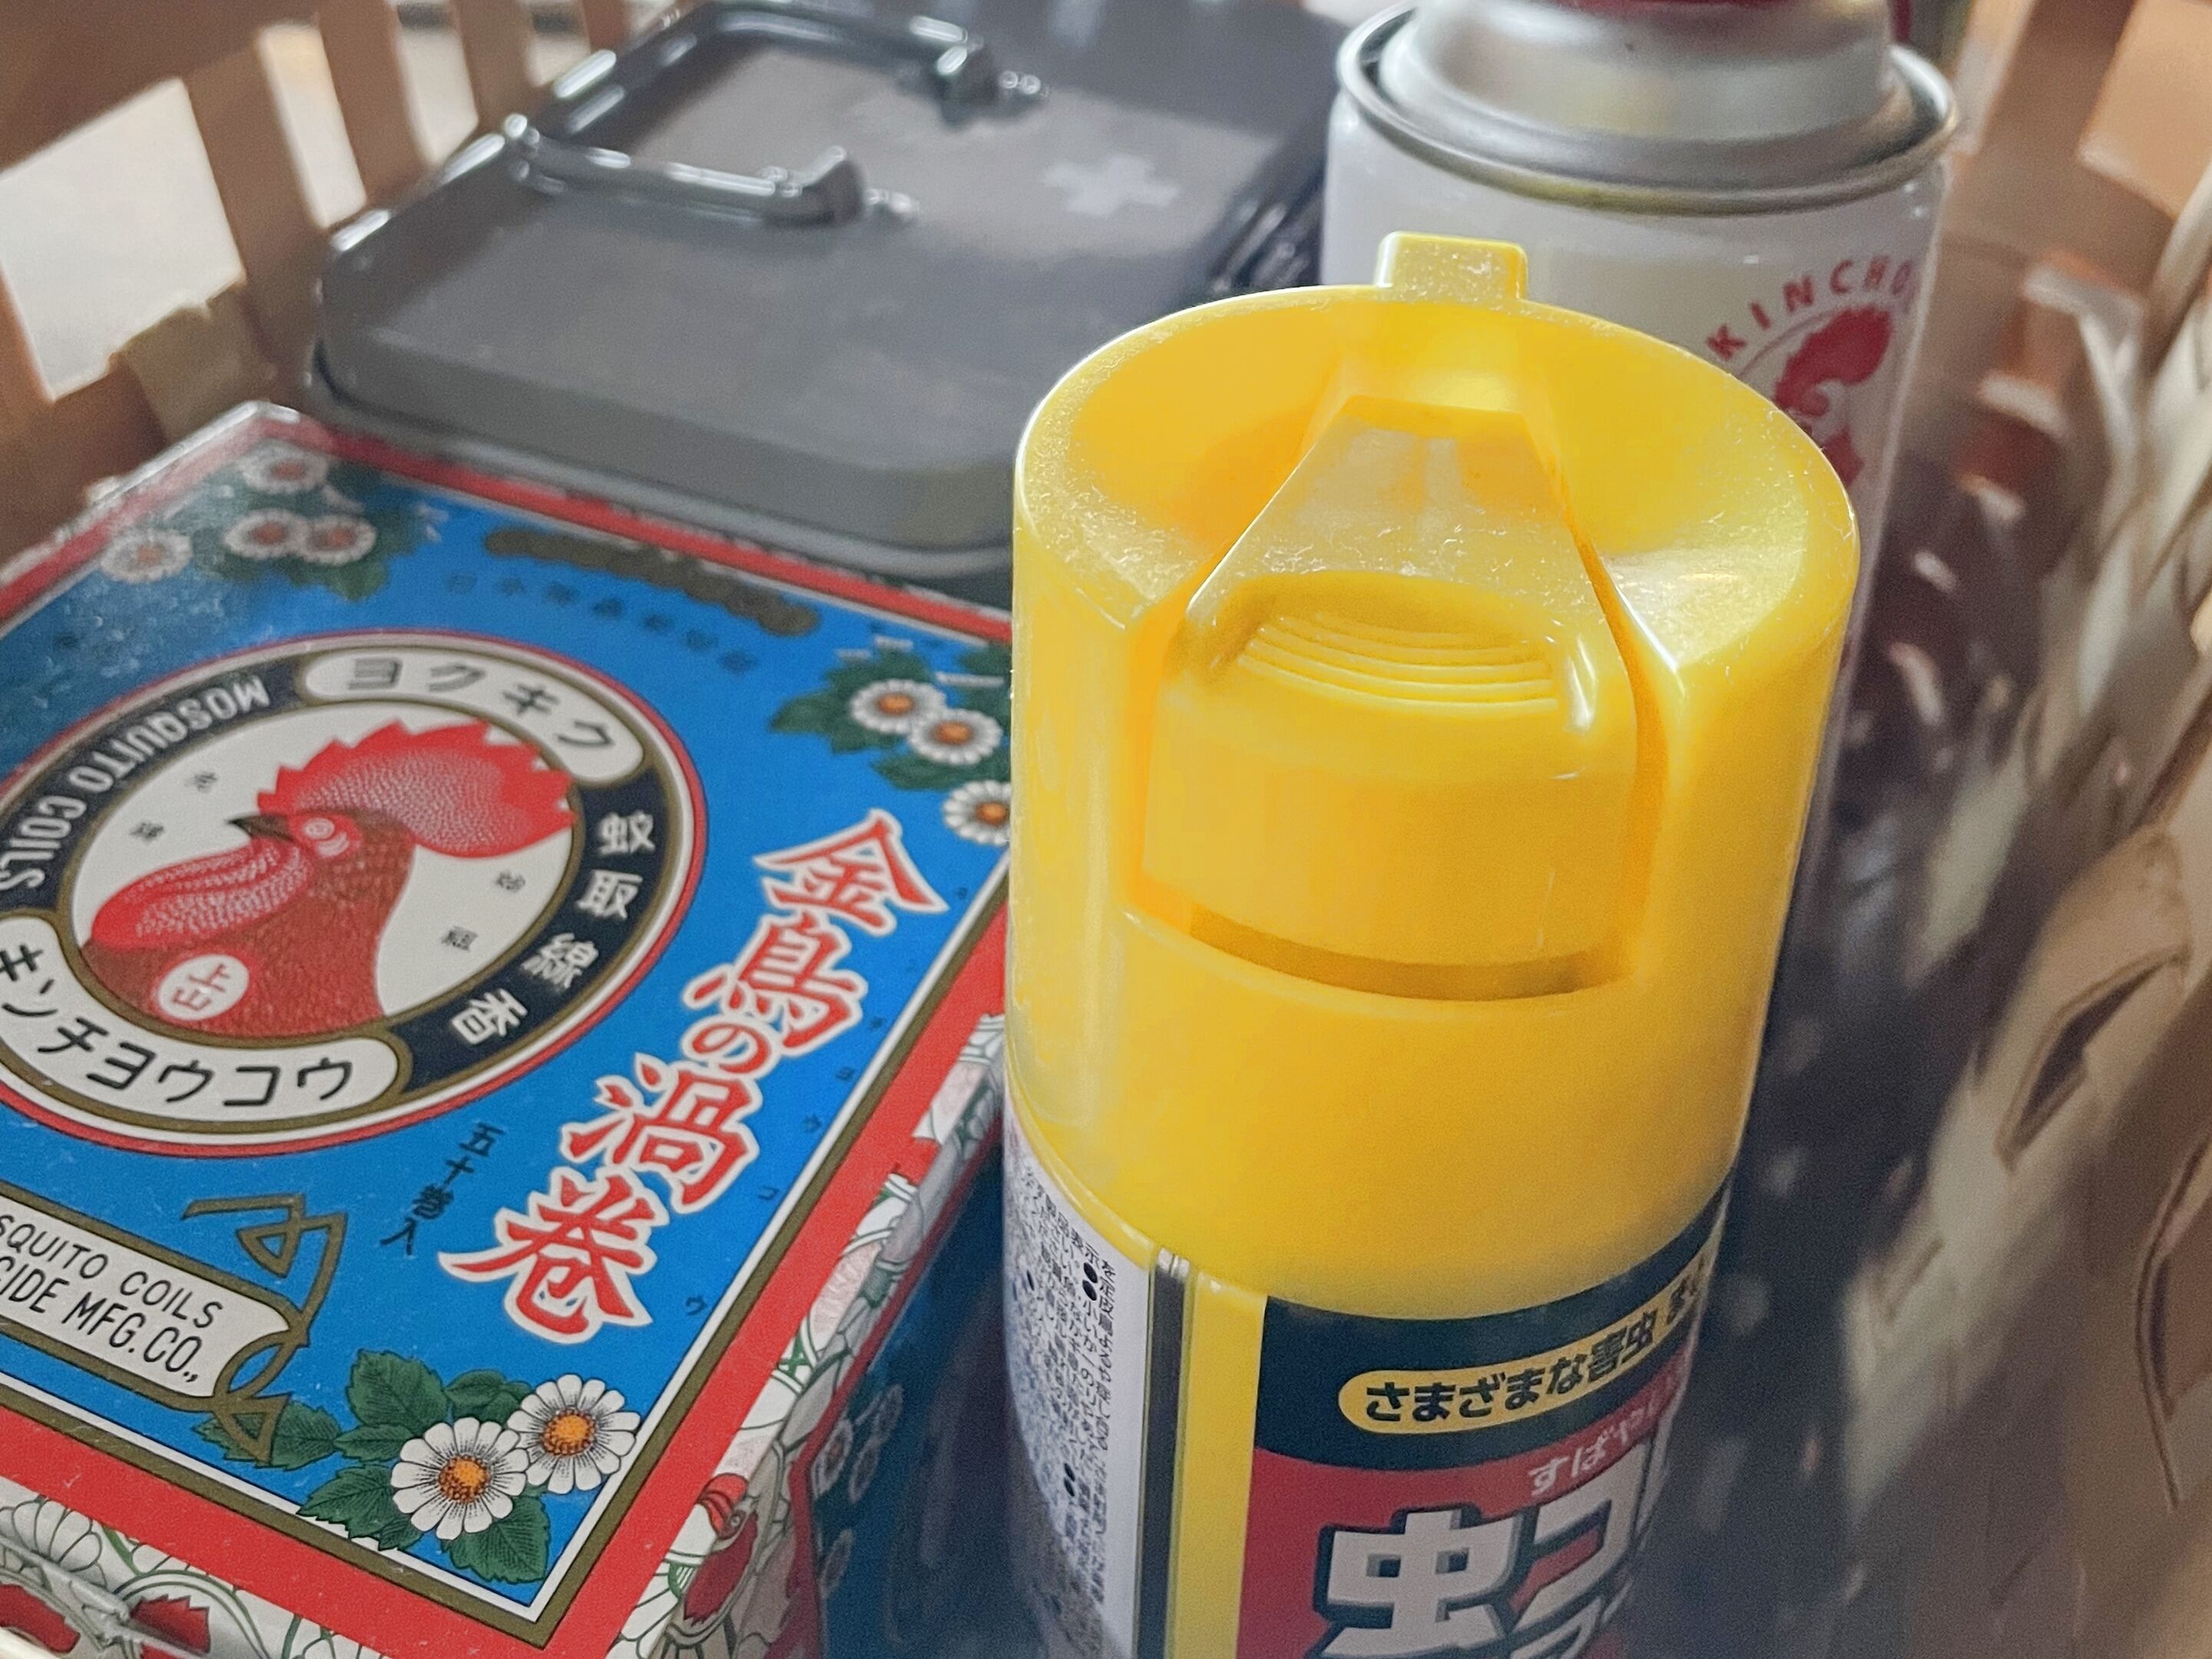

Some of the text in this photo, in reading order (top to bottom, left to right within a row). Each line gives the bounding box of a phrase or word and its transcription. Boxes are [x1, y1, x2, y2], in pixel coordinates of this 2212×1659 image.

[1705, 254, 1914, 361] KINCHO
[0, 674, 270, 891] MOSQUITO COILS
[450, 810, 656, 1045] 蚊取線香
[439, 809, 949, 1346] 金鳥の渦巻
[379, 1122, 505, 1257] 五十巻入
[120, 1270, 224, 1329] COILS
[1365, 1308, 1657, 1423] さまざまな害虫
